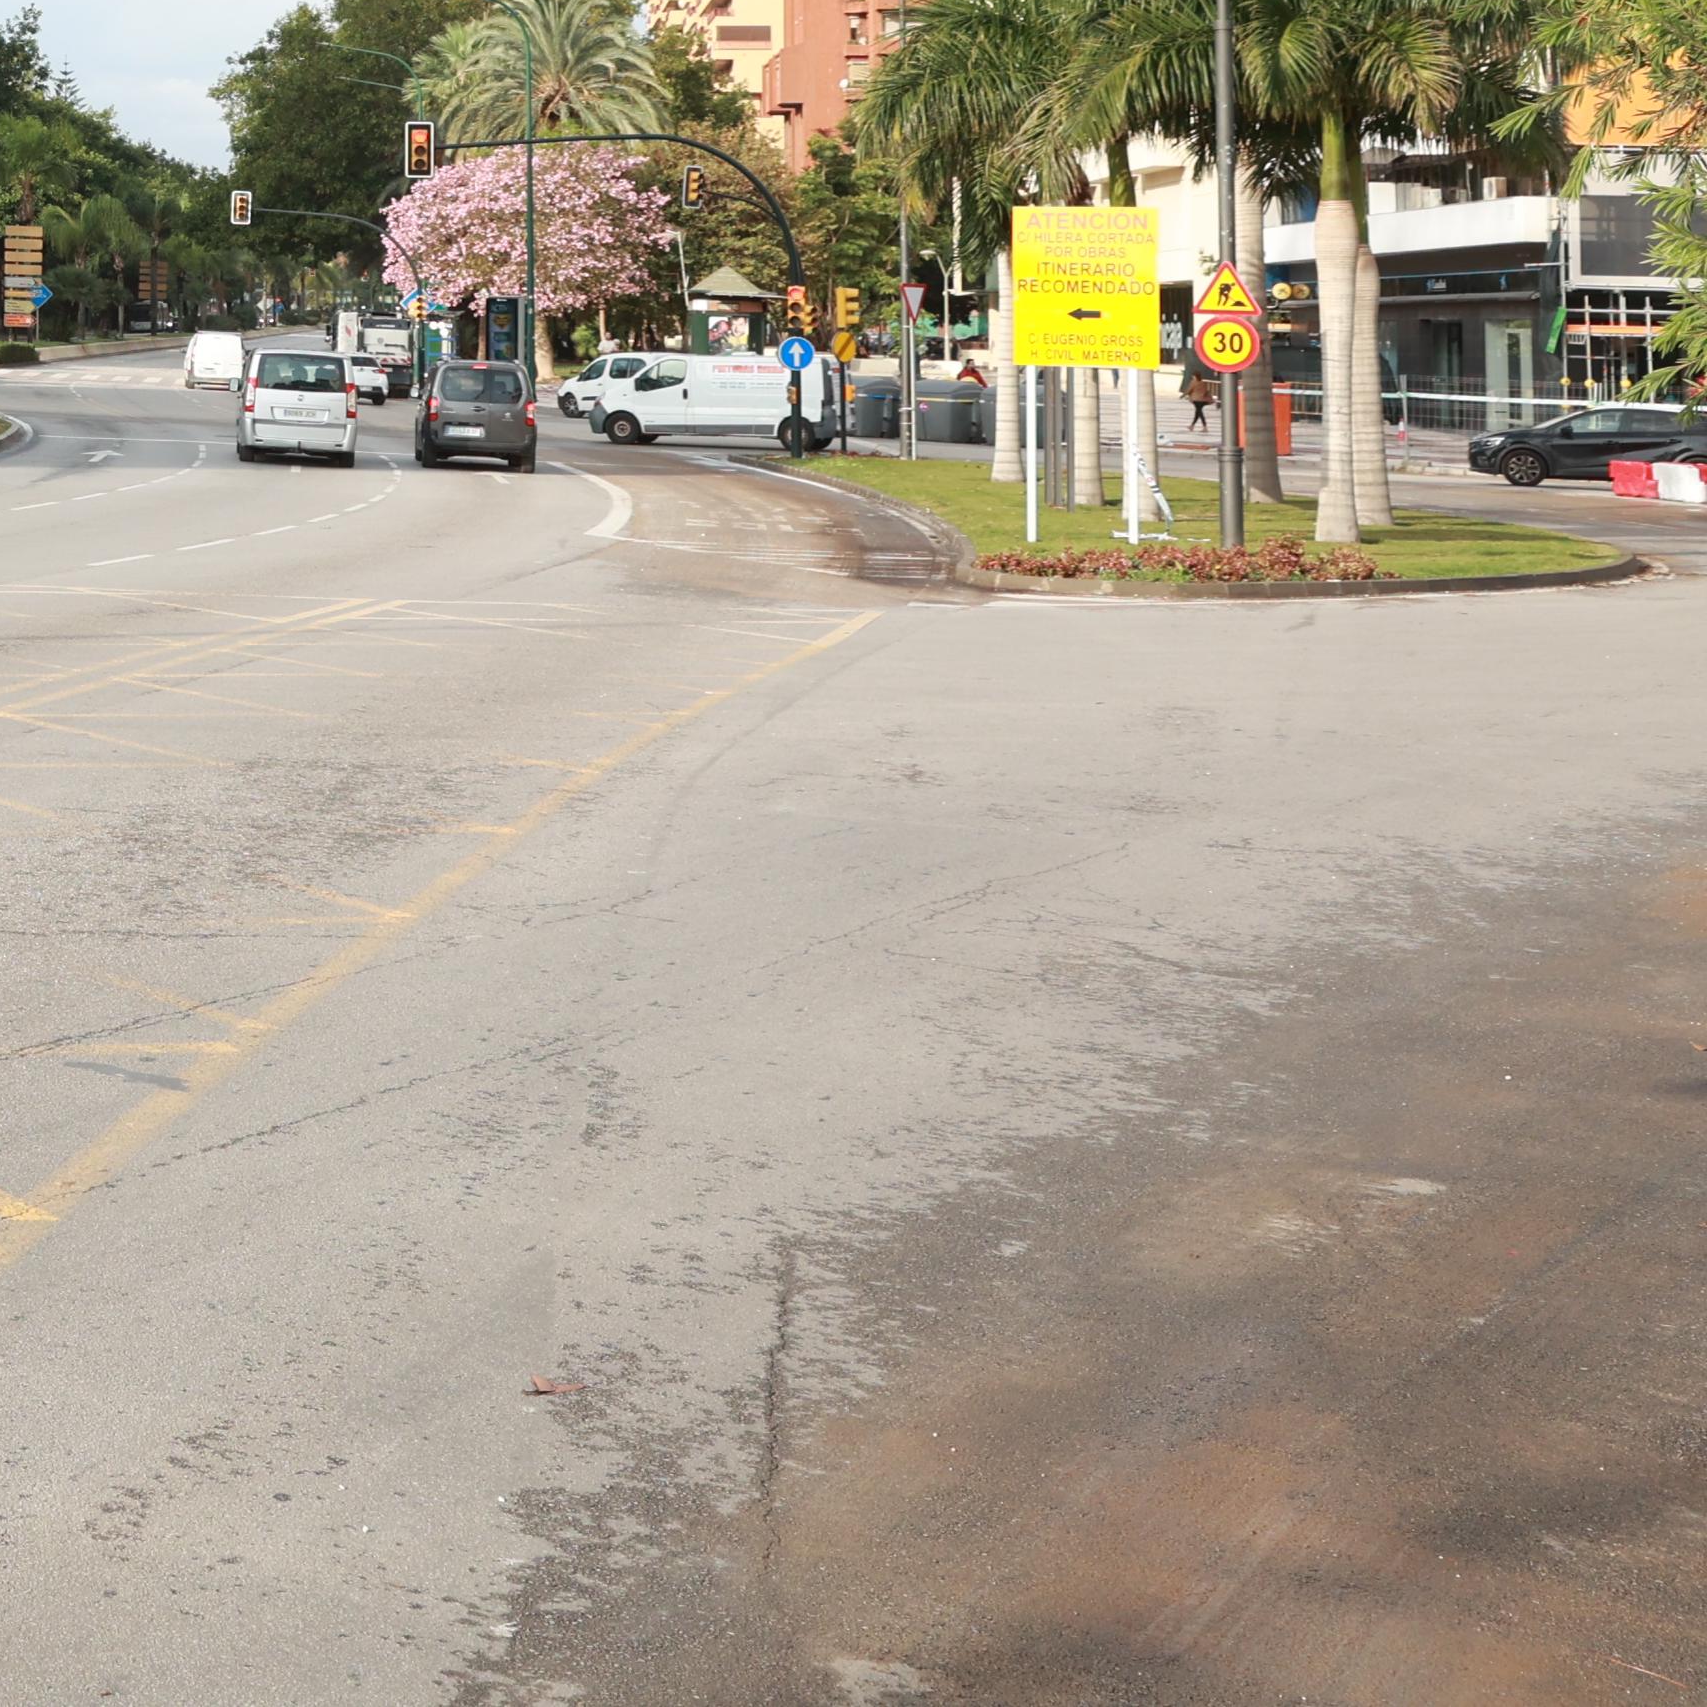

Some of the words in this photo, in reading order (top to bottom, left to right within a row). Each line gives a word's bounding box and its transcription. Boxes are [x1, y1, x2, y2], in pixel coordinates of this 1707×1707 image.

[1026, 209, 1148, 230] ATENCIÓN
[1034, 232, 1083, 243] HILERA
[1087, 233, 1154, 244] CORTADA
[1045, 246, 1073, 258] POR
[1077, 246, 1127, 259] OBRAS
[1036, 261, 1136, 277] ITINERARIO
[1017, 279, 1155, 296] RECOMENDADO
[1043, 332, 1097, 346] EUGENIO
[1100, 334, 1144, 347] GROSS
[1213, 331, 1244, 354] 30
[1082, 349, 1141, 362] MATERNO
